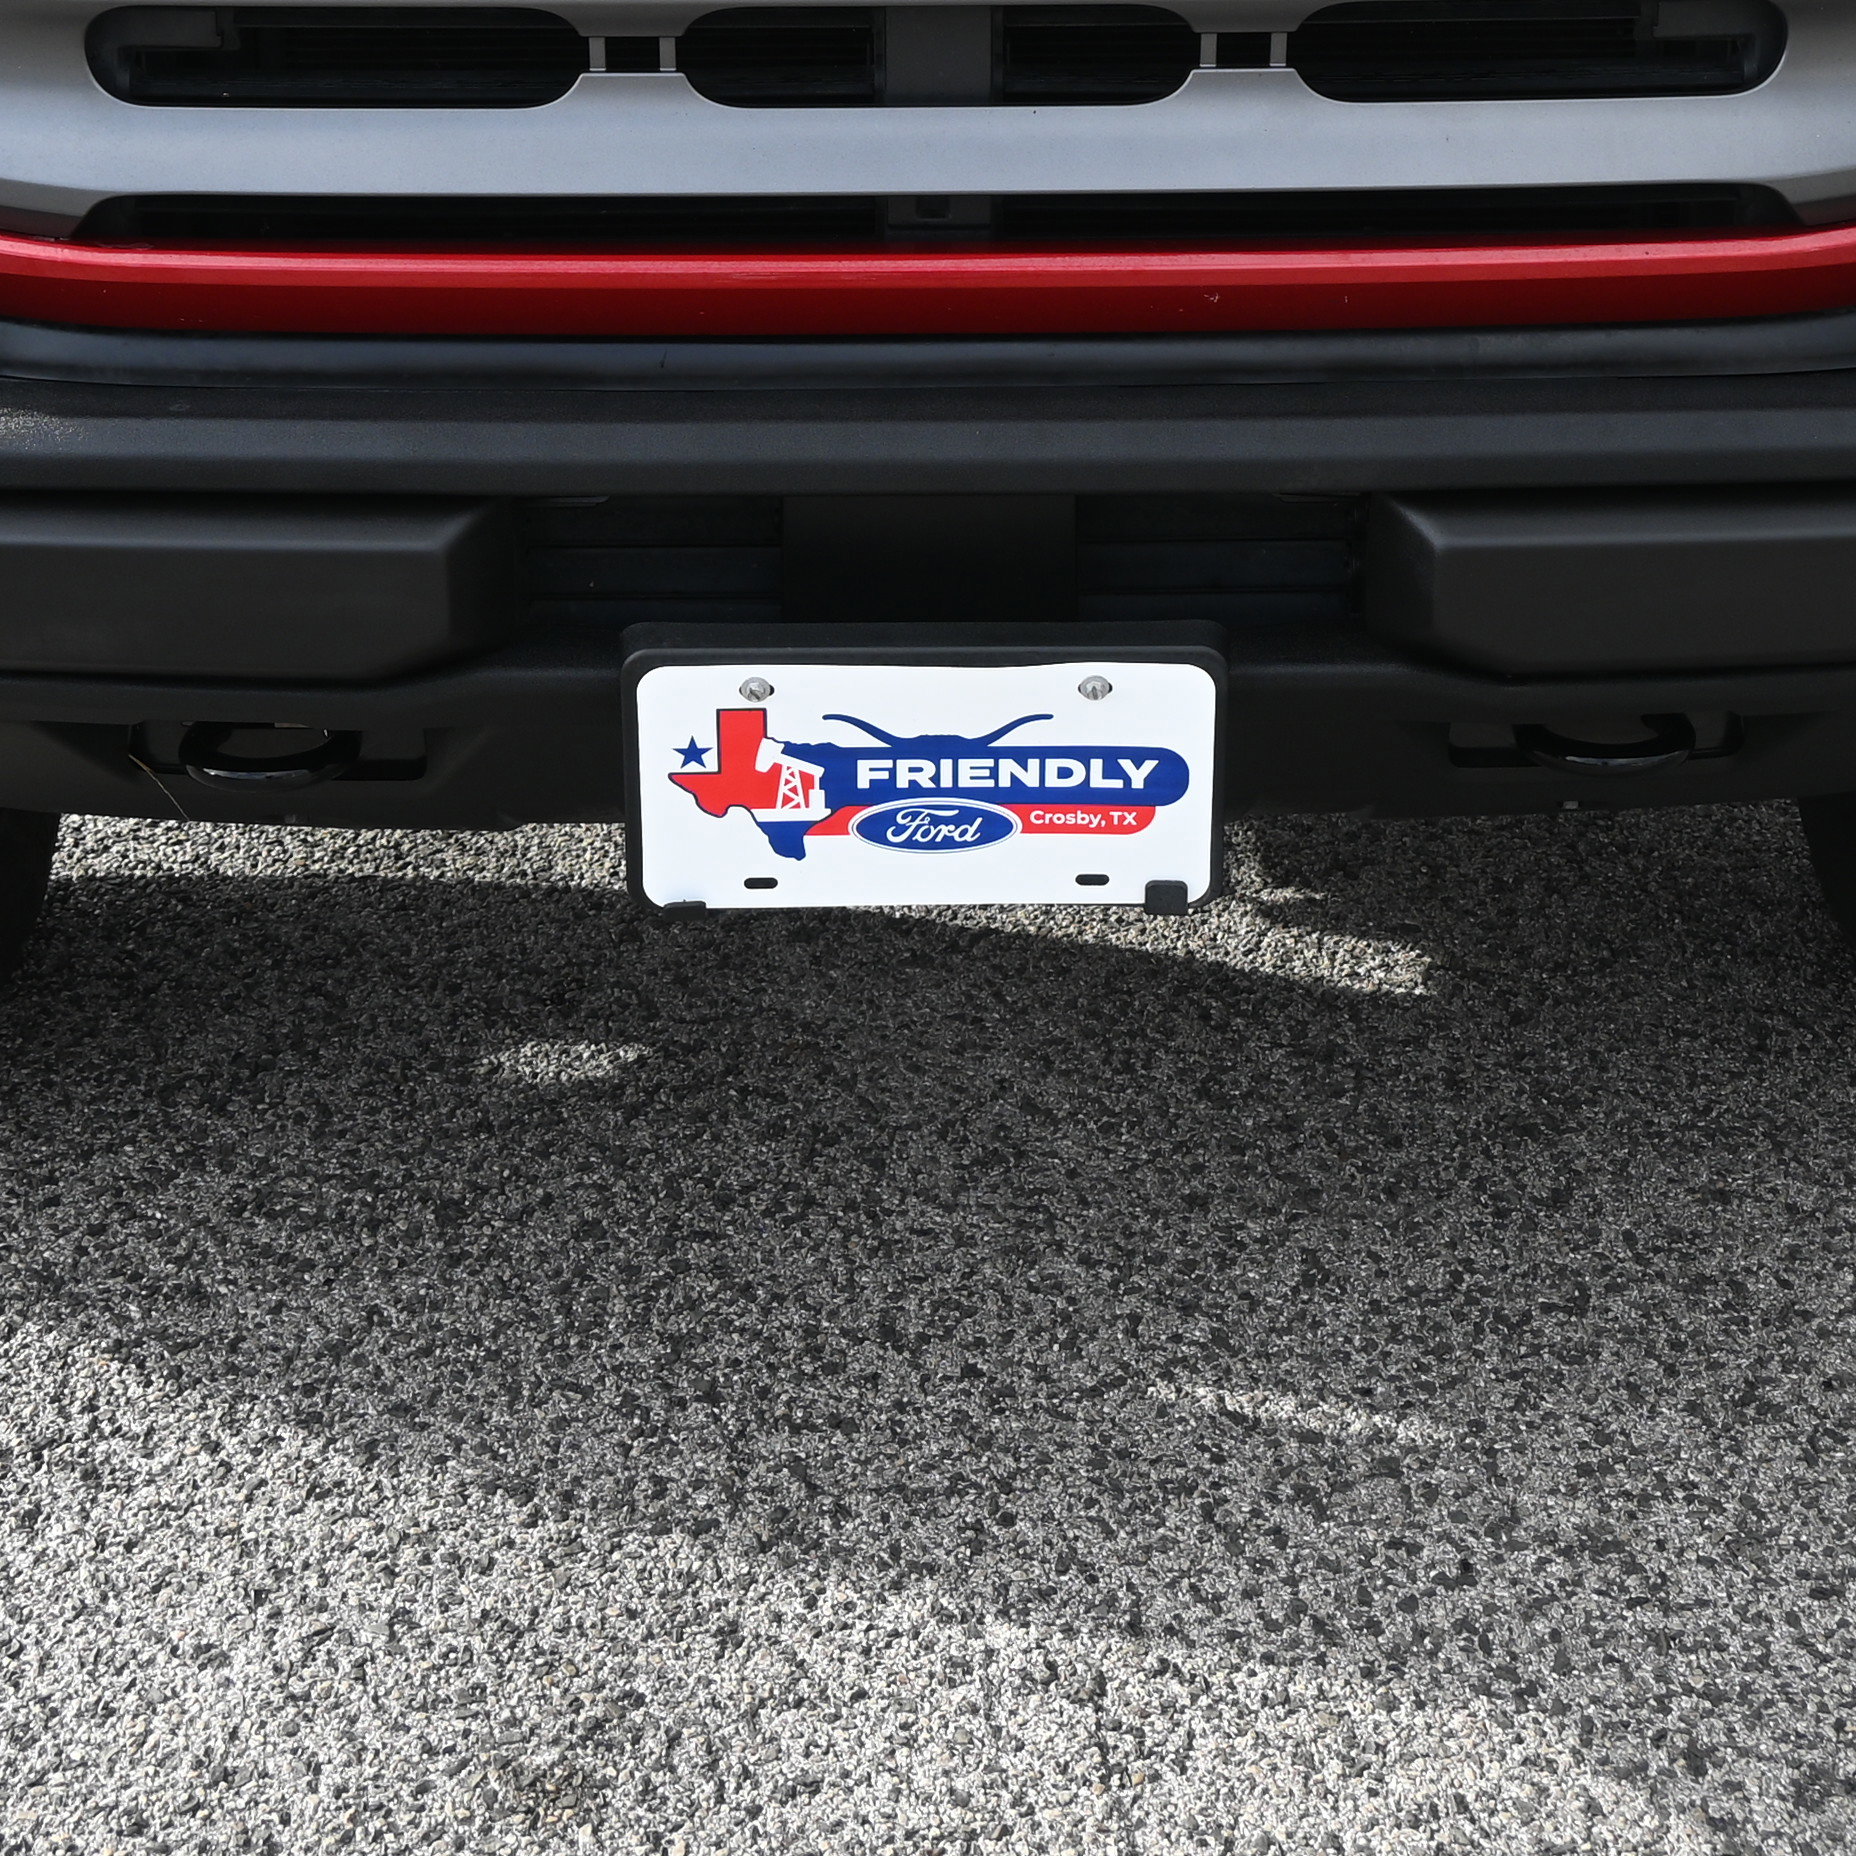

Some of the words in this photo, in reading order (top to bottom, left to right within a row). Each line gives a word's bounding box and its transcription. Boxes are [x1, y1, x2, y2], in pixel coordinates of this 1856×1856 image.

[856, 758, 1160, 790] FRIENDLY
[886, 807, 983, 845] Ford
[1029, 809, 1106, 829] Crosby,
[1110, 810, 1138, 827] TX
